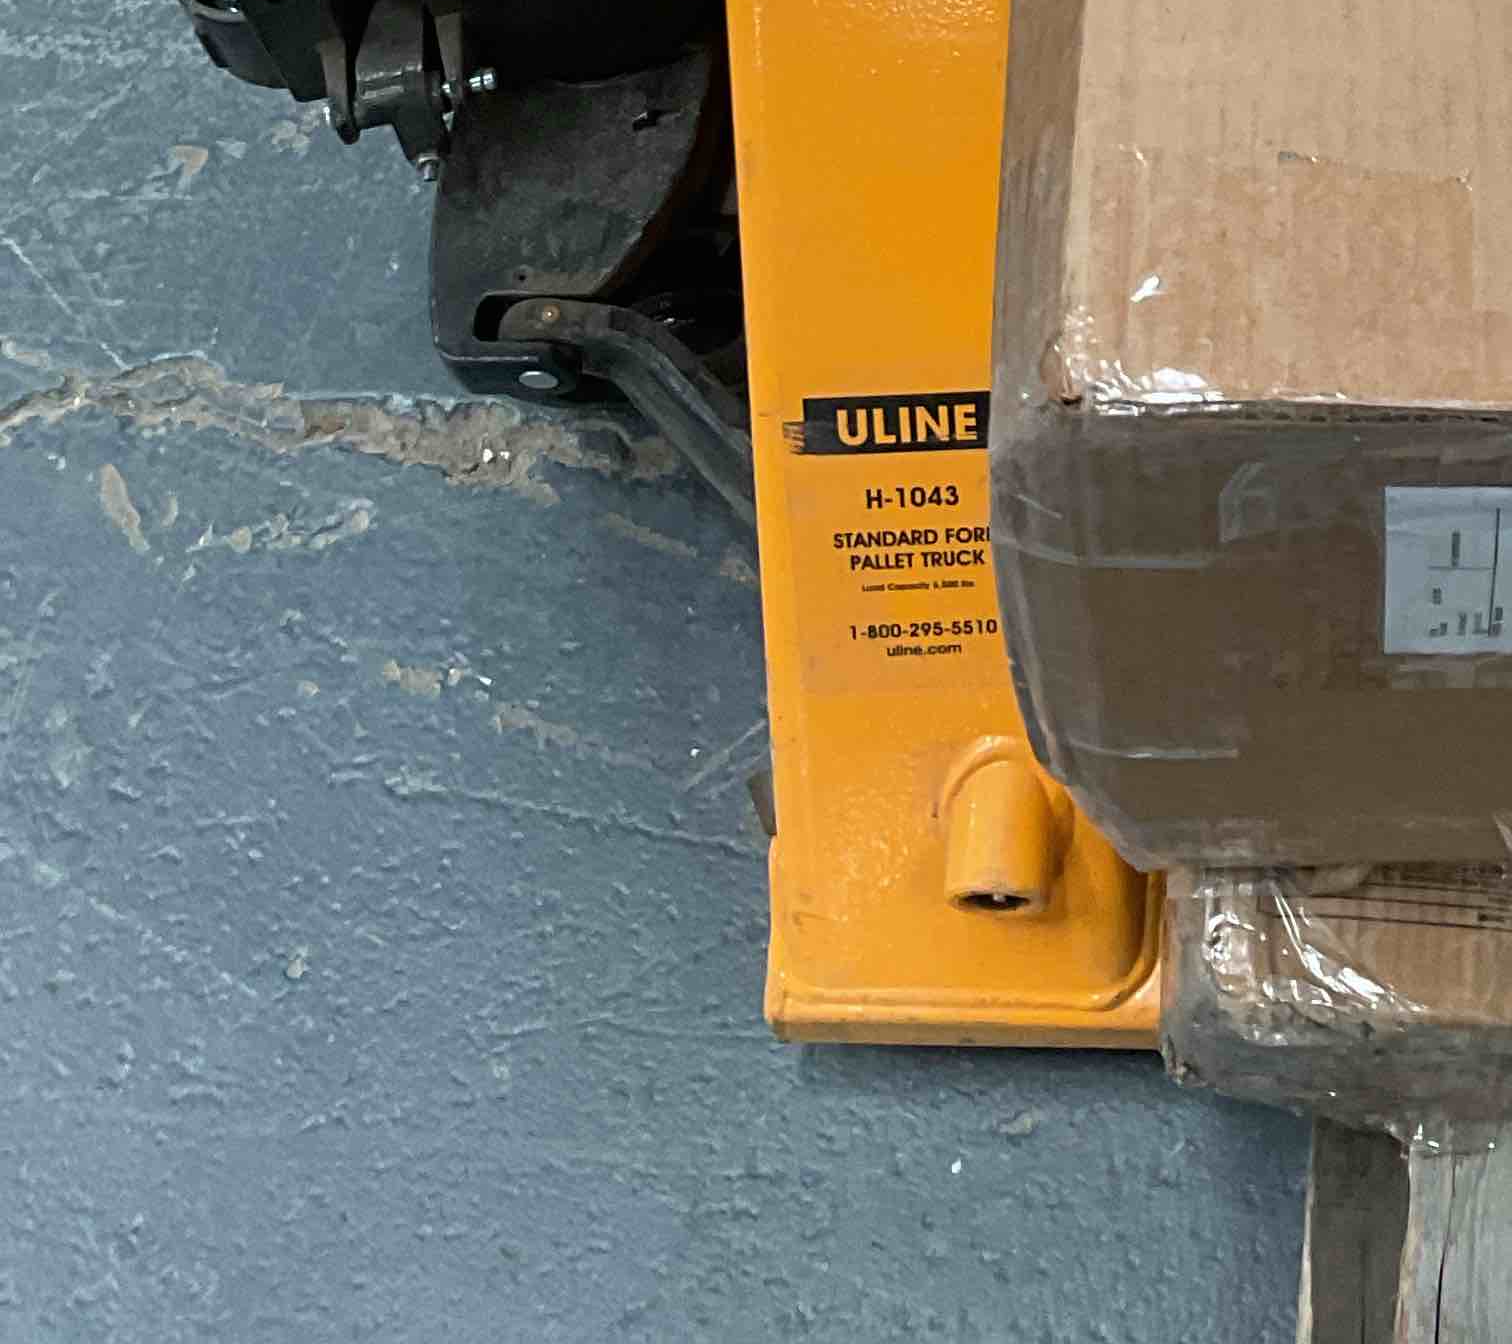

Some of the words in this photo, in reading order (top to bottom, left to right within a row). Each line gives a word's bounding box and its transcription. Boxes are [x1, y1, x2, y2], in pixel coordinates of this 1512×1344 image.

[836, 403, 978, 447] ULINE
[865, 485, 960, 510] H-1043
[833, 528, 939, 550] STANDARD
[945, 525, 991, 545] FOR
[850, 552, 915, 571] PALLET
[921, 548, 986, 568] TRUCK
[849, 618, 998, 641] 1-800-295-5510
[886, 641, 963, 658] uline.com
